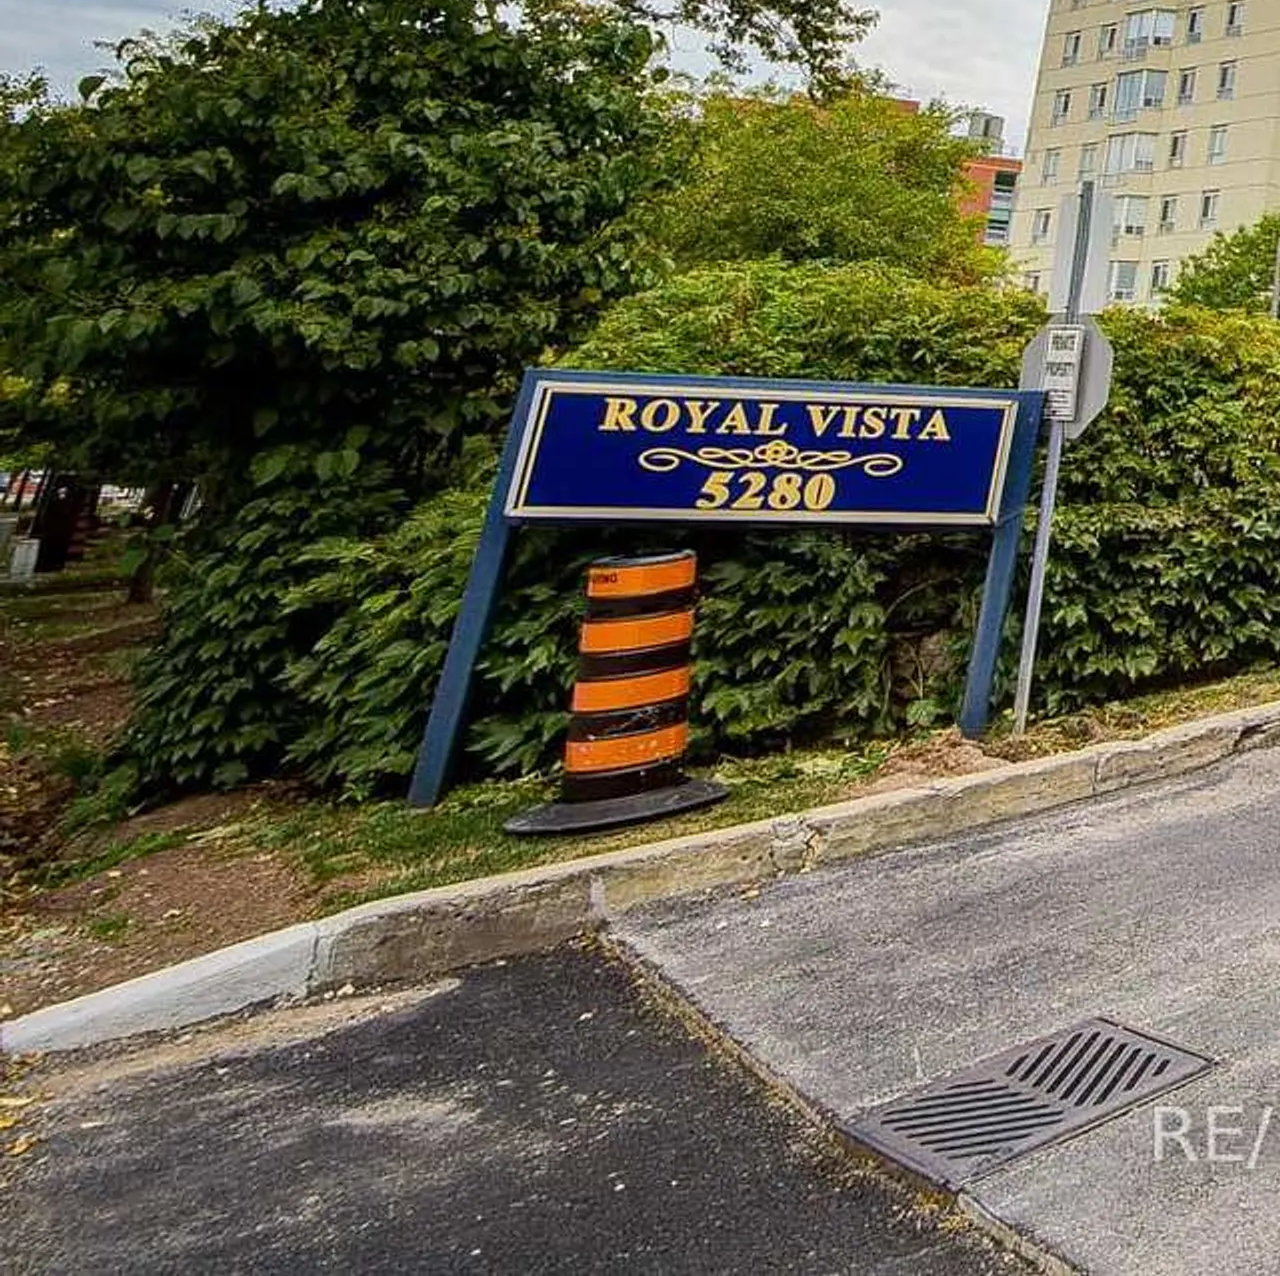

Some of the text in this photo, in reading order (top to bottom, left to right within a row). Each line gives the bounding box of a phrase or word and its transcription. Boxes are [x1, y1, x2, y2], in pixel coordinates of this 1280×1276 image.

[598, 397, 951, 441] ROYAL VISTA
[695, 471, 836, 510] 5280
